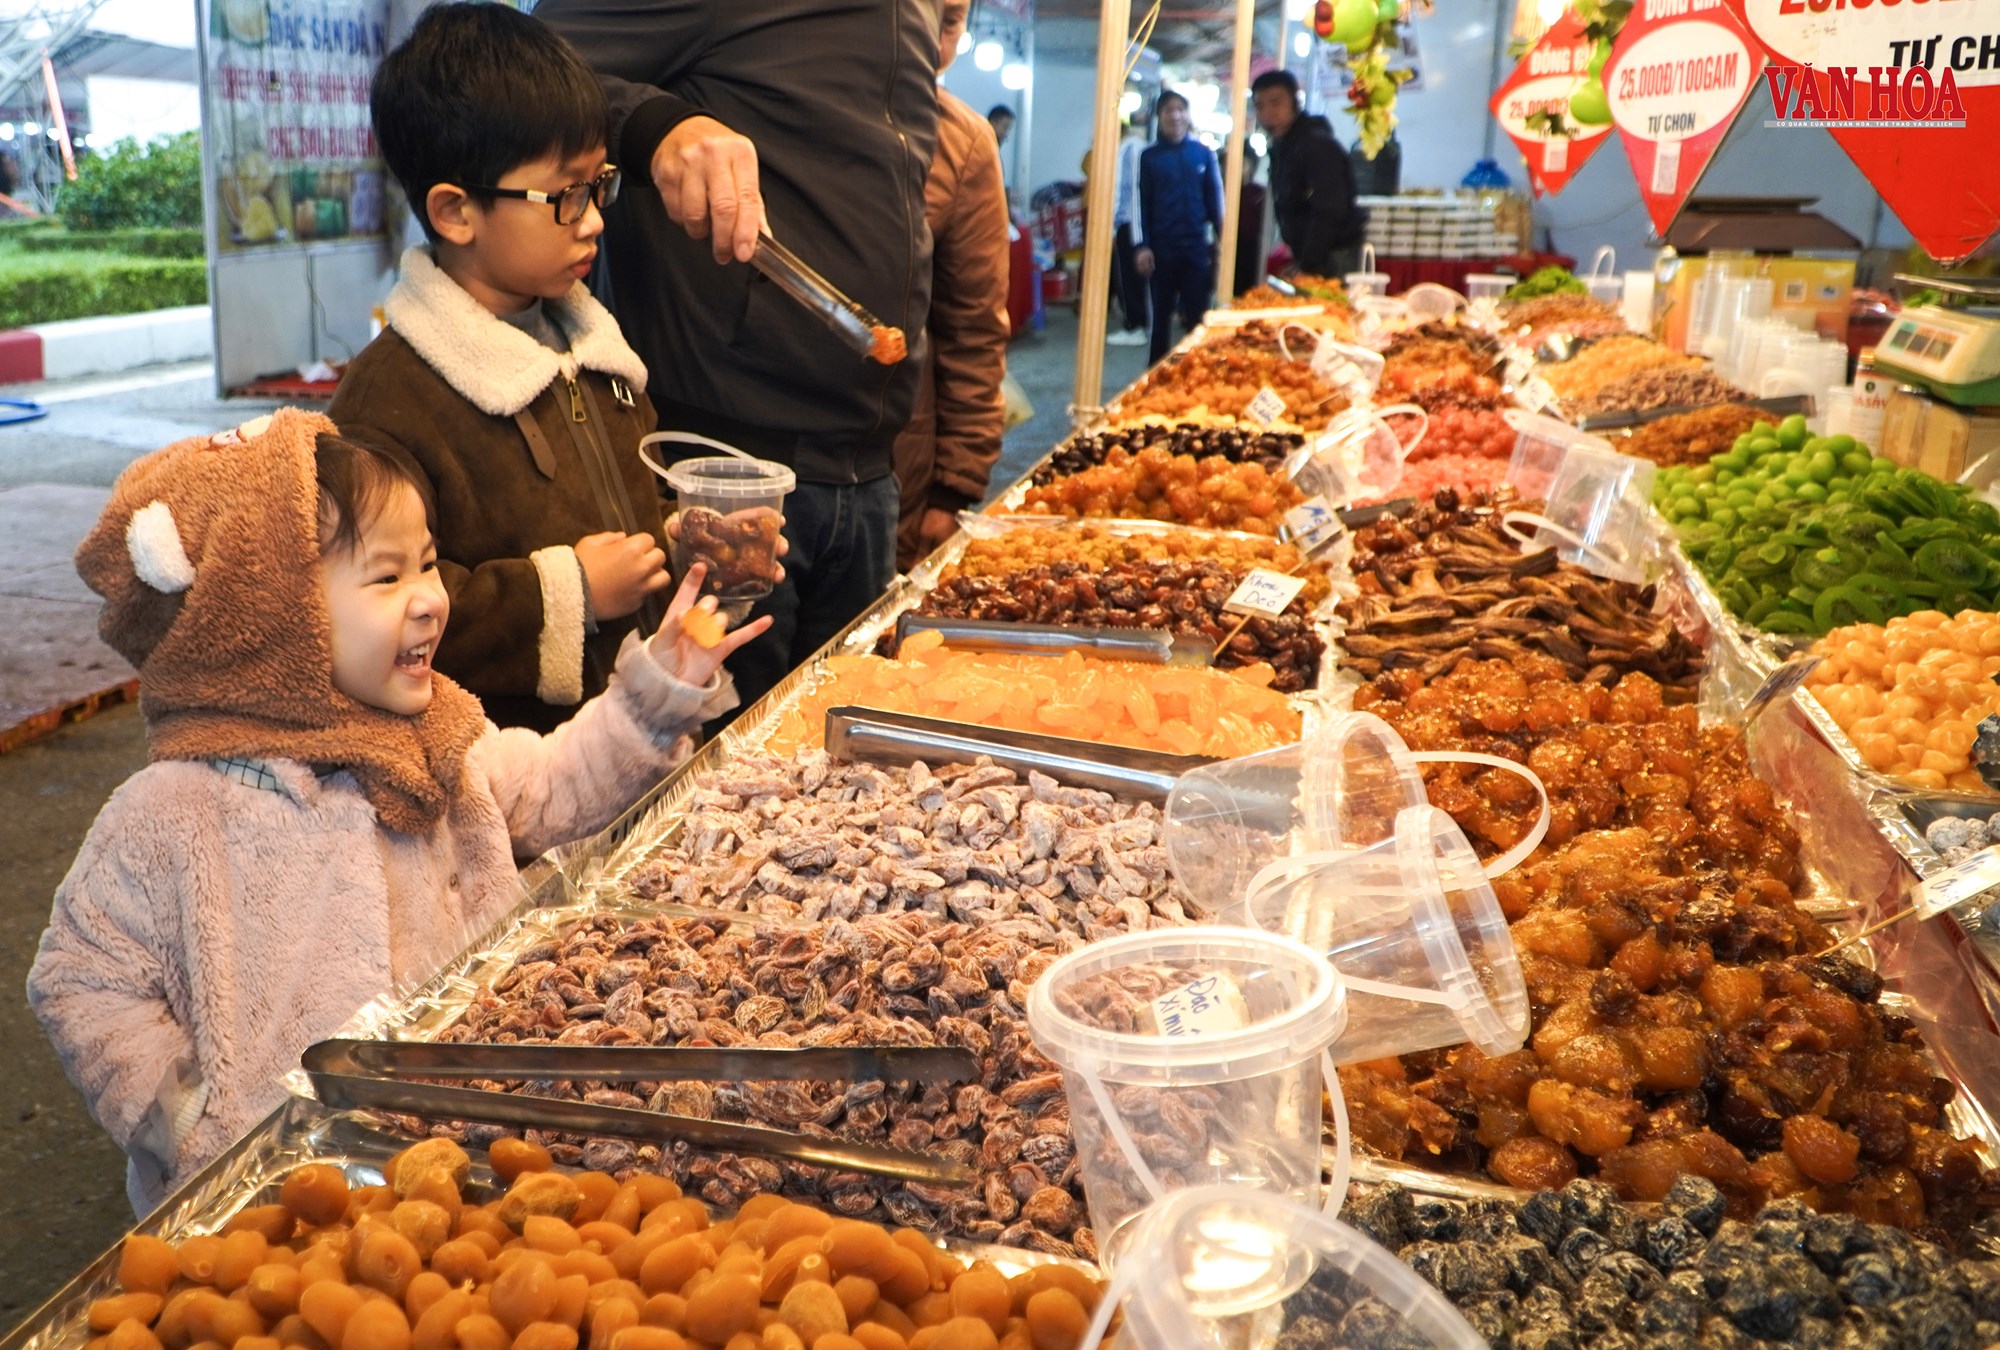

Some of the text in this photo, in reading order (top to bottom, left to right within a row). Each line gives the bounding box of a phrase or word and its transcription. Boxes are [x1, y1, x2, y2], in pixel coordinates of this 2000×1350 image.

[1950, 35, 2000, 72] CH
[1619, 52, 1738, 101] 25.000Đ/100GAM
[1664, 112, 1696, 136] CHỌN
